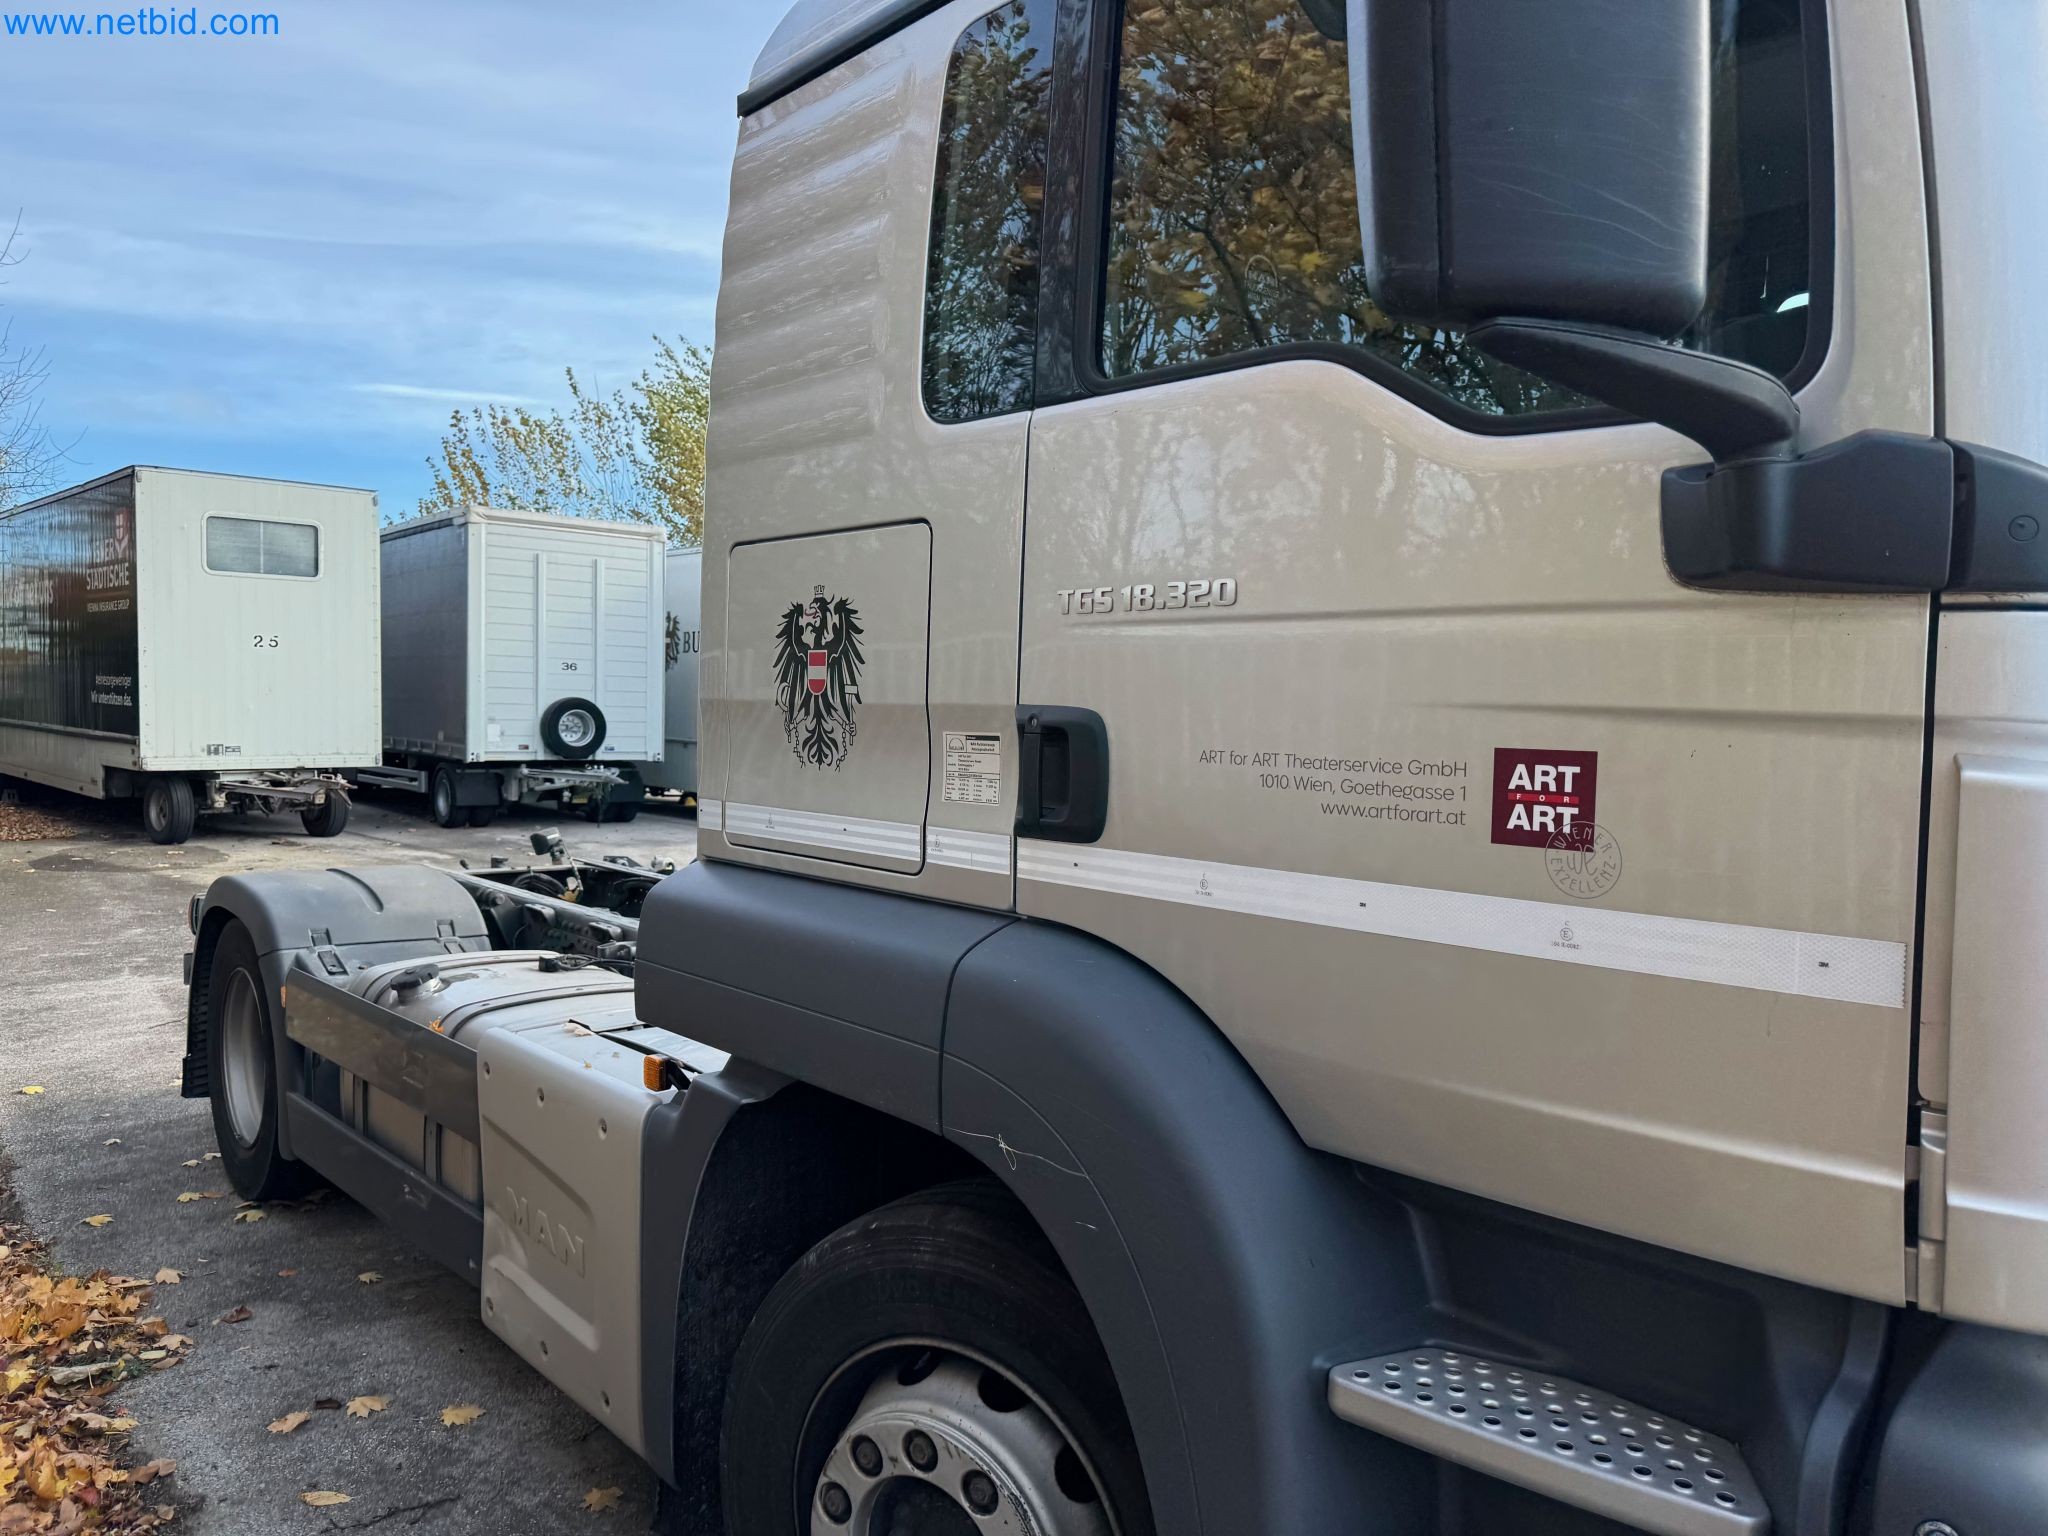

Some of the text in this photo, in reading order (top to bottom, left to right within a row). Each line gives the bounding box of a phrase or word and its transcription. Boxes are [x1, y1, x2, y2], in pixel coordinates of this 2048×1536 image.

[1057, 577, 1238, 616] TGS 18.320
[561, 662, 578, 671] 36
[1199, 750, 1467, 778] ART for ART Theaterservice GmbH
[1508, 763, 1581, 793] ART
[1259, 773, 1467, 801] 1010 Wien, Goethegasse 1
[1516, 794, 1570, 804] FOR
[1321, 803, 1467, 826] www.artforart.at
[1506, 804, 1579, 834] ART
[1553, 827, 1613, 853] WIENER
[506, 1186, 585, 1278] MAN
